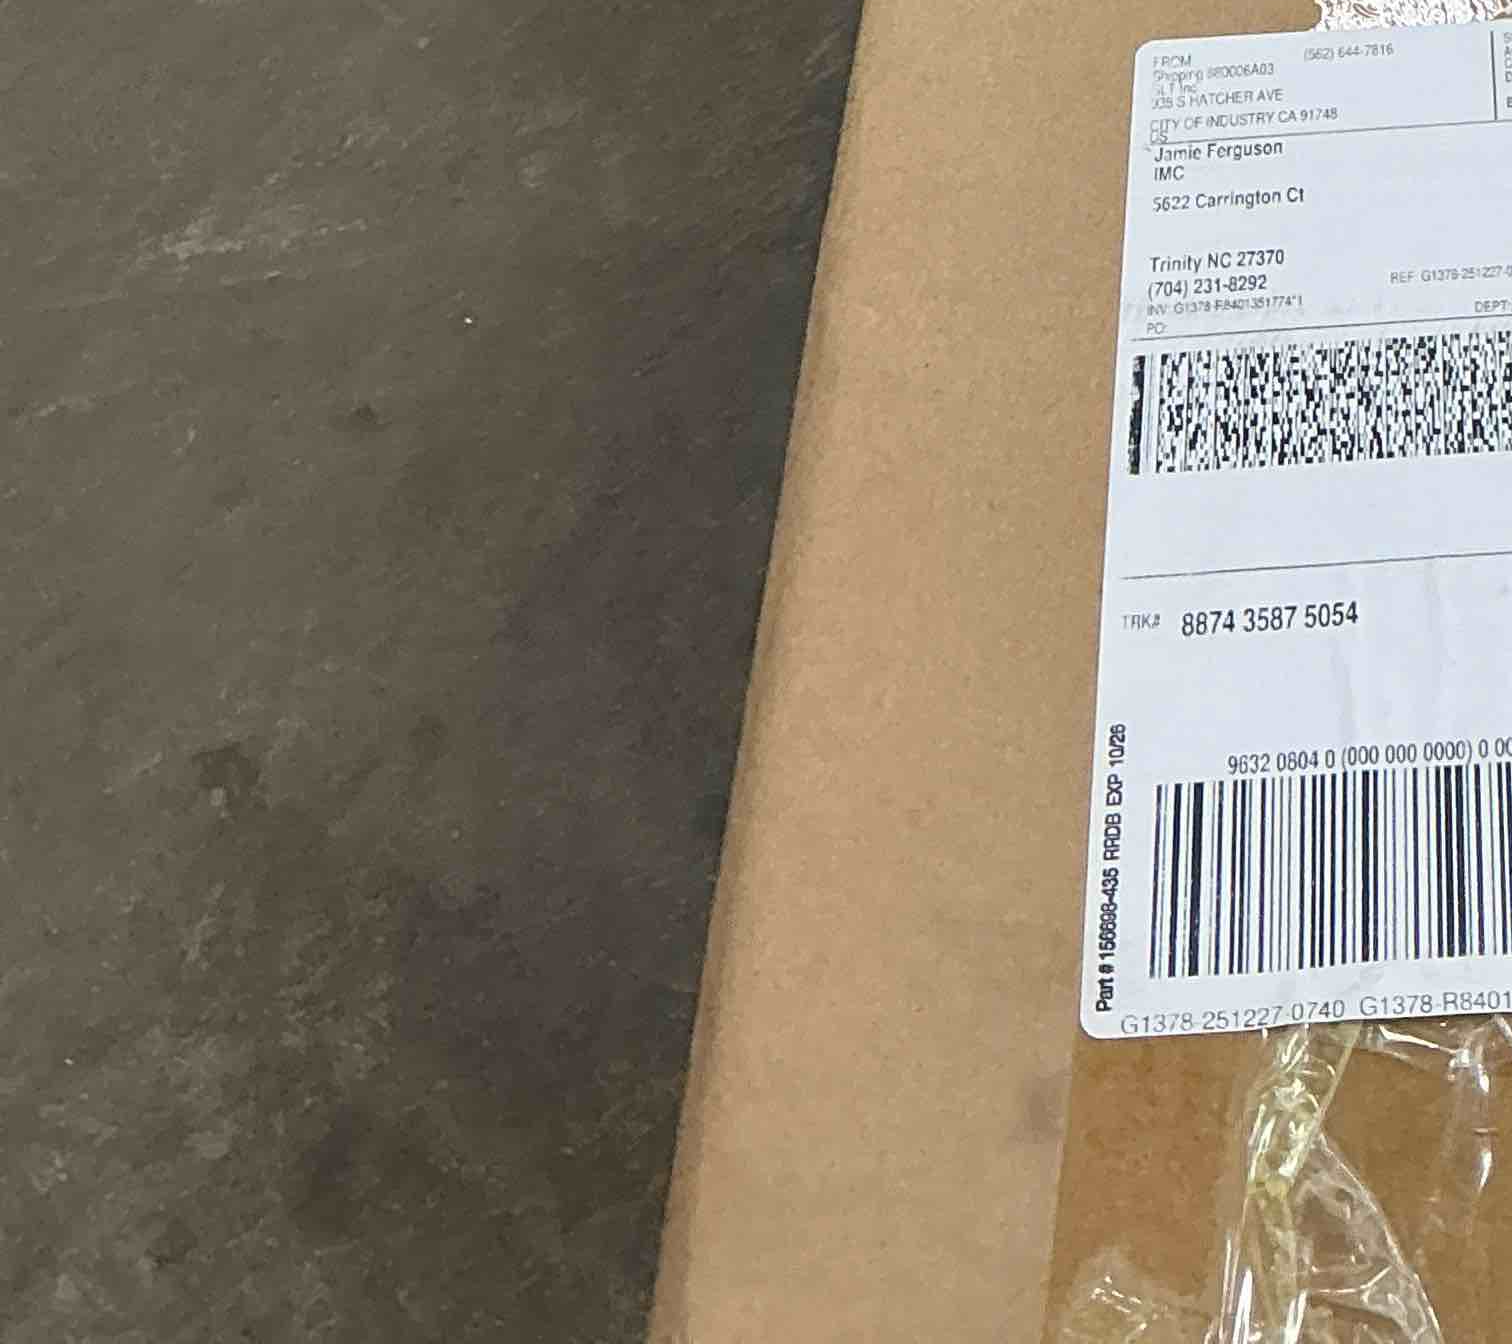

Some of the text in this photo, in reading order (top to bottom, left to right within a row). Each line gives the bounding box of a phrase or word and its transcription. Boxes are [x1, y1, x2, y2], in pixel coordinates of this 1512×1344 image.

[1176, 94, 1187, 108] S
[1189, 90, 1254, 107] HATCHER
[1256, 87, 1284, 102] AVE
[1150, 118, 1180, 133] CITY
[1184, 115, 1205, 129] OF
[1206, 110, 1275, 127] INDUSTRY
[1277, 108, 1298, 123] CA
[1153, 141, 1284, 163] Jamie Ferguson
[1153, 165, 1185, 182] IMC
[1152, 187, 1305, 212] 5622 Carrington Ct
[1150, 249, 1285, 274] Trinity NC 27370
[1147, 274, 1267, 302] (704) 231-8292
[1181, 609, 1236, 637] 8874
[1242, 605, 1296, 632] 3587
[1303, 600, 1359, 628] 5054
[1227, 753, 1270, 775] 9632
[1275, 750, 1320, 772] 0804
[1324, 749, 1336, 769] 0
[1341, 745, 1379, 772] (000
[1384, 743, 1417, 765] 000
[1423, 739, 1473, 765] 0000)
[1477, 739, 1489, 759] 0
[1106, 773, 1123, 805] EXP
[1105, 812, 1122, 861] RRDB
[1096, 975, 1114, 1013] Part
